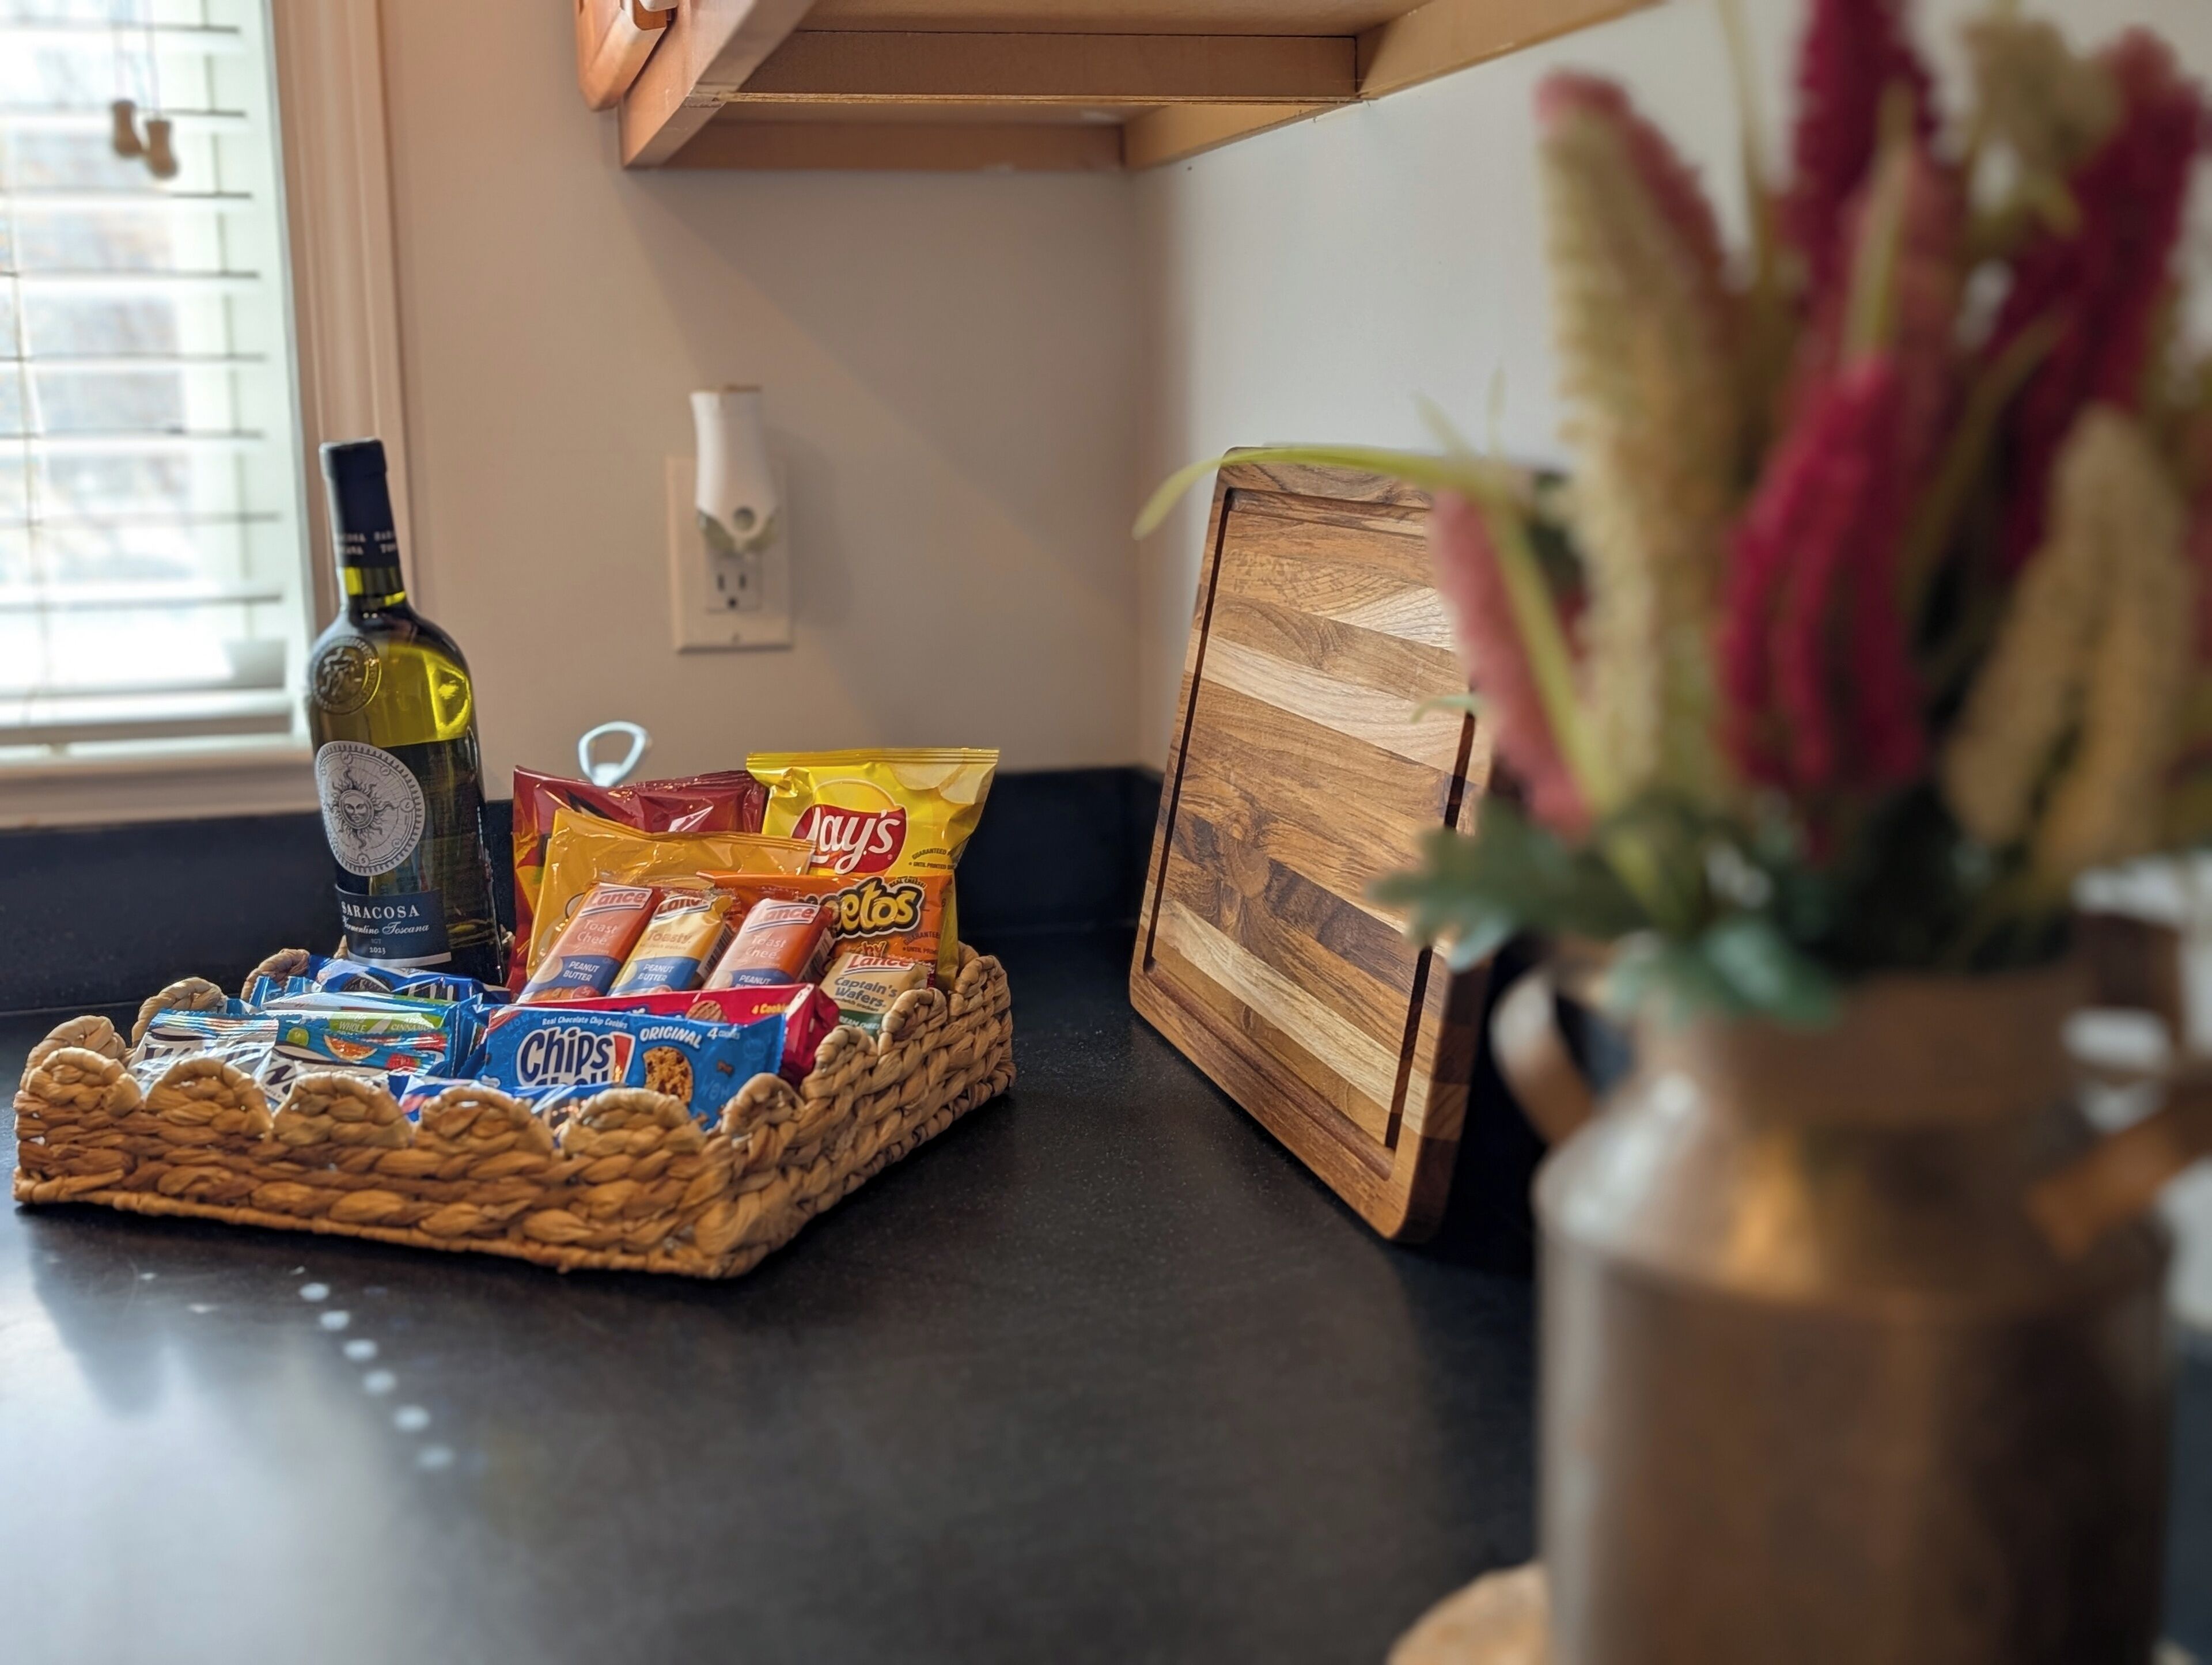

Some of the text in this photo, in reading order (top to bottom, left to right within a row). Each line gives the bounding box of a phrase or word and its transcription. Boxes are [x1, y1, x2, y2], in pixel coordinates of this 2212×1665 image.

[805, 806, 901, 874] Lay's
[911, 848, 946, 860] GUARANTEED
[592, 891, 646, 905] Lance
[341, 901, 420, 919] SARACOSA
[382, 921, 430, 935] Toscana
[584, 919, 619, 934] Toast
[751, 934, 787, 949] Toast
[369, 947, 387, 955] 2023
[568, 960, 600, 973] PEANUT
[643, 964, 675, 973] PEANUT
[562, 969, 593, 983] BUTTER
[637, 972, 668, 982] BUTTER
[738, 974, 772, 985] PEANUT
[834, 977, 898, 998] Captain's
[759, 1003, 788, 1014] Cooki
[338, 1021, 367, 1033] WHOLE
[391, 1023, 431, 1033] CINNAMO
[542, 1016, 628, 1029] Real Chocolate Chip Cookies
[639, 1026, 702, 1049] ORIGINAL
[707, 1027, 719, 1040] 4
[520, 1028, 614, 1083] Chips
